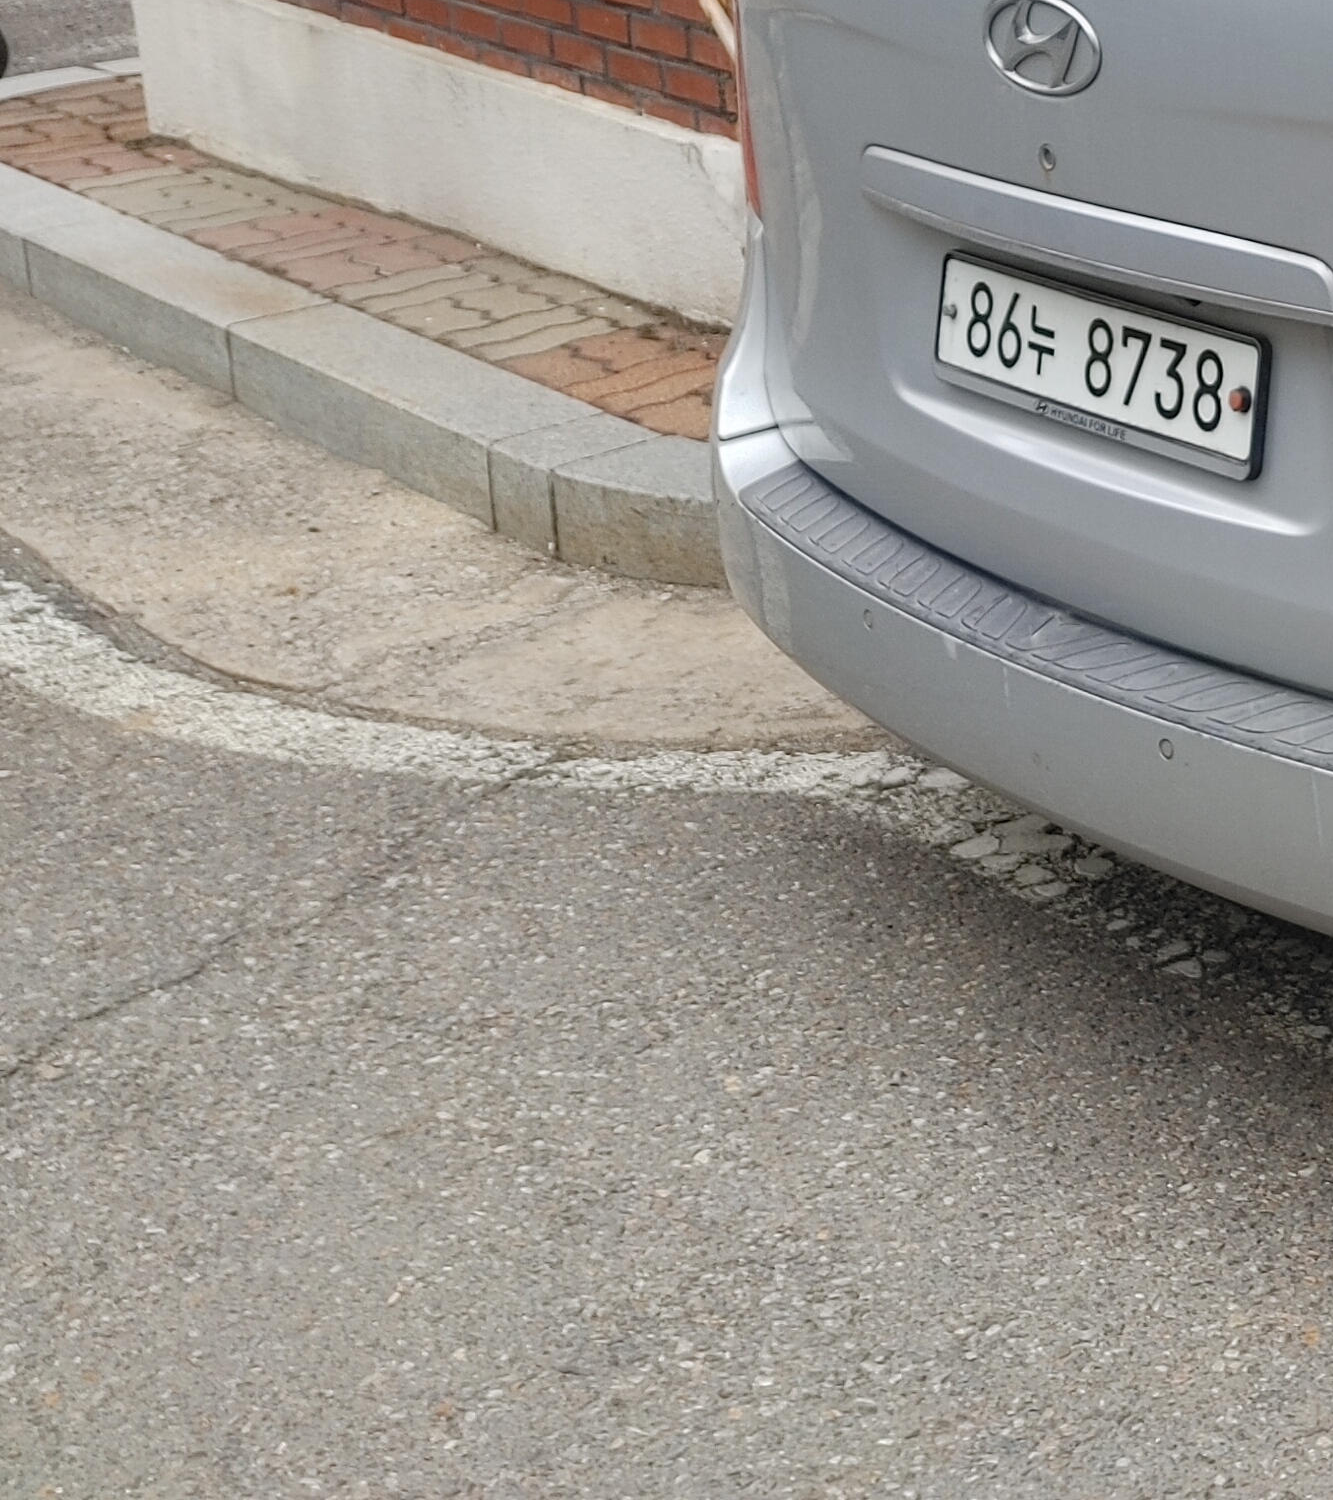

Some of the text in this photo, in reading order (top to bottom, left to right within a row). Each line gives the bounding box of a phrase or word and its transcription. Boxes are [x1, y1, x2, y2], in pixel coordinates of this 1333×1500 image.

[966, 280, 1225, 433] 86누 8738
[1049, 408, 1088, 429] HYUNDAI
